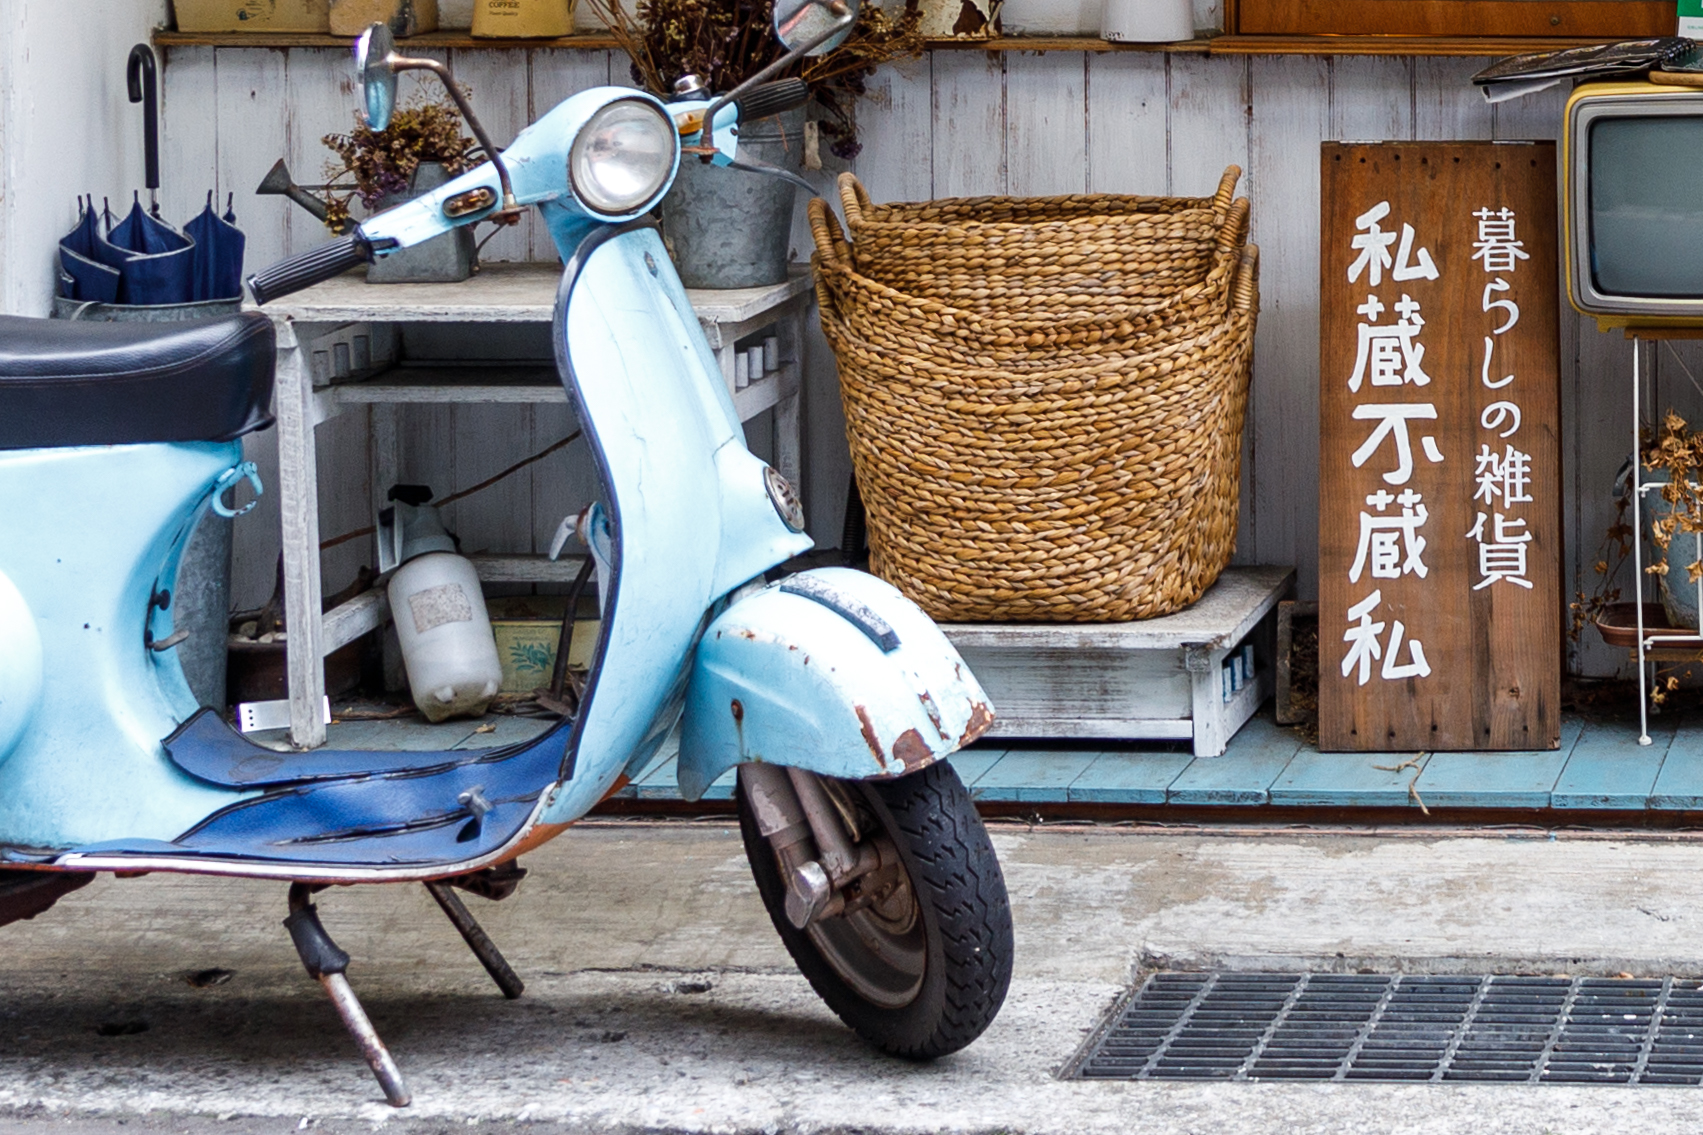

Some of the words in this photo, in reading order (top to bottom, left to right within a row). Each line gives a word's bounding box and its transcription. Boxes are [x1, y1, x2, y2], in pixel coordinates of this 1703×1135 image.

[1341, 200, 1445, 686] 私蔵不蔵私
[1466, 206, 1533, 591] 暮らしの雑貨
